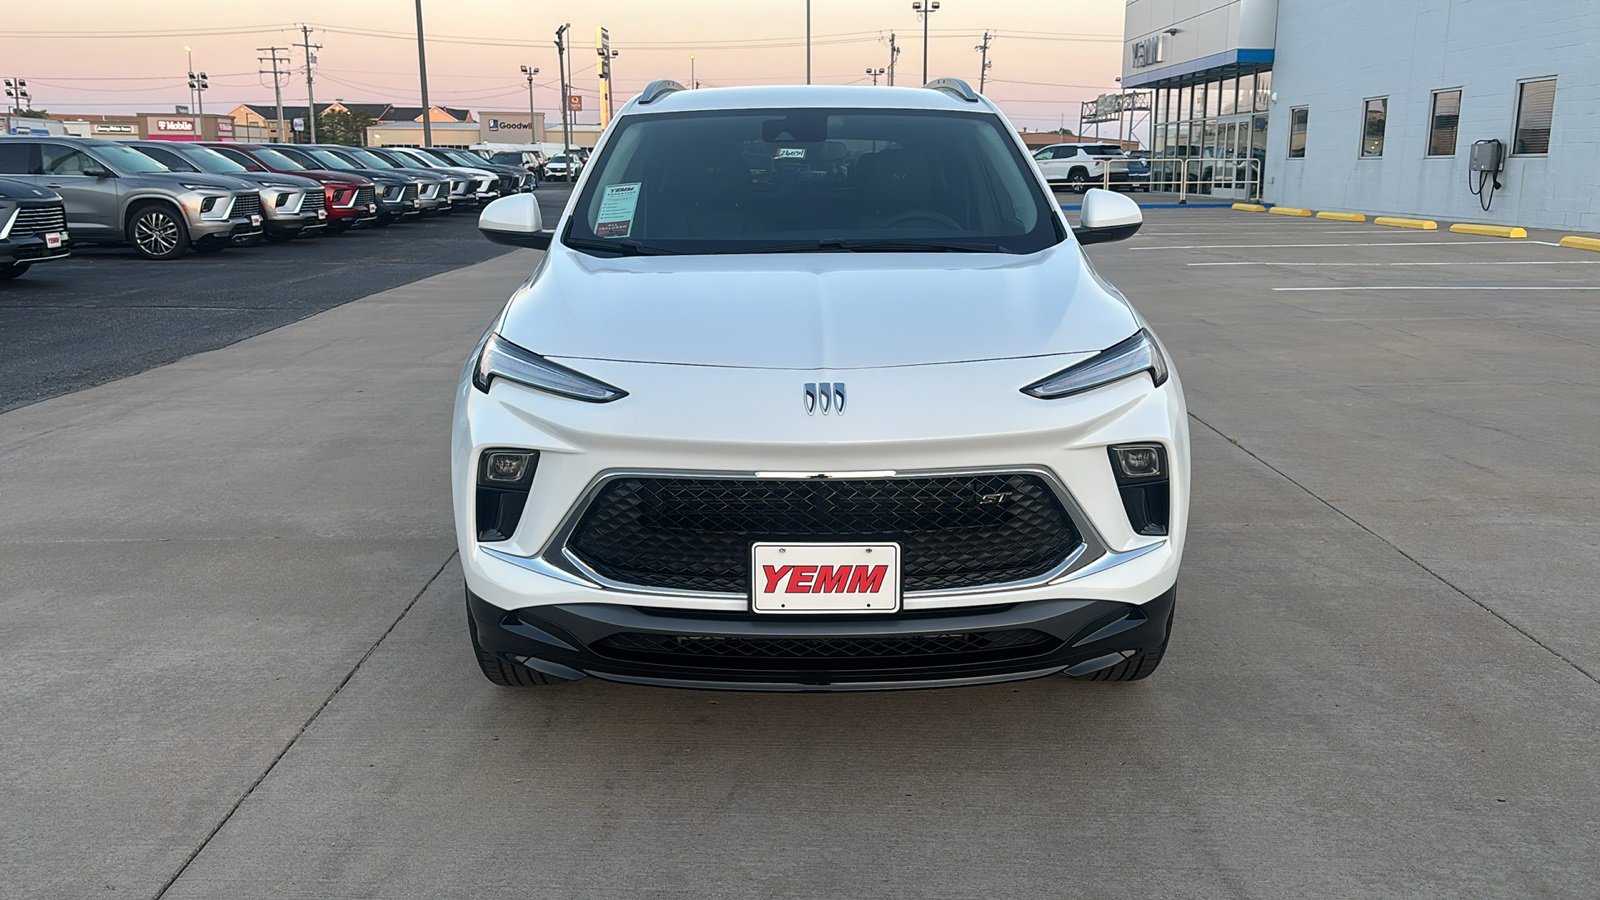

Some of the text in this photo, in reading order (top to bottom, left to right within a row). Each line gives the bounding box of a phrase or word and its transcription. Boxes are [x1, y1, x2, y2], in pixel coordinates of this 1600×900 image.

[166, 121, 193, 131] Mobile
[499, 121, 534, 130] Goodwil
[979, 491, 1013, 505] ST
[762, 564, 888, 594] YEMM
